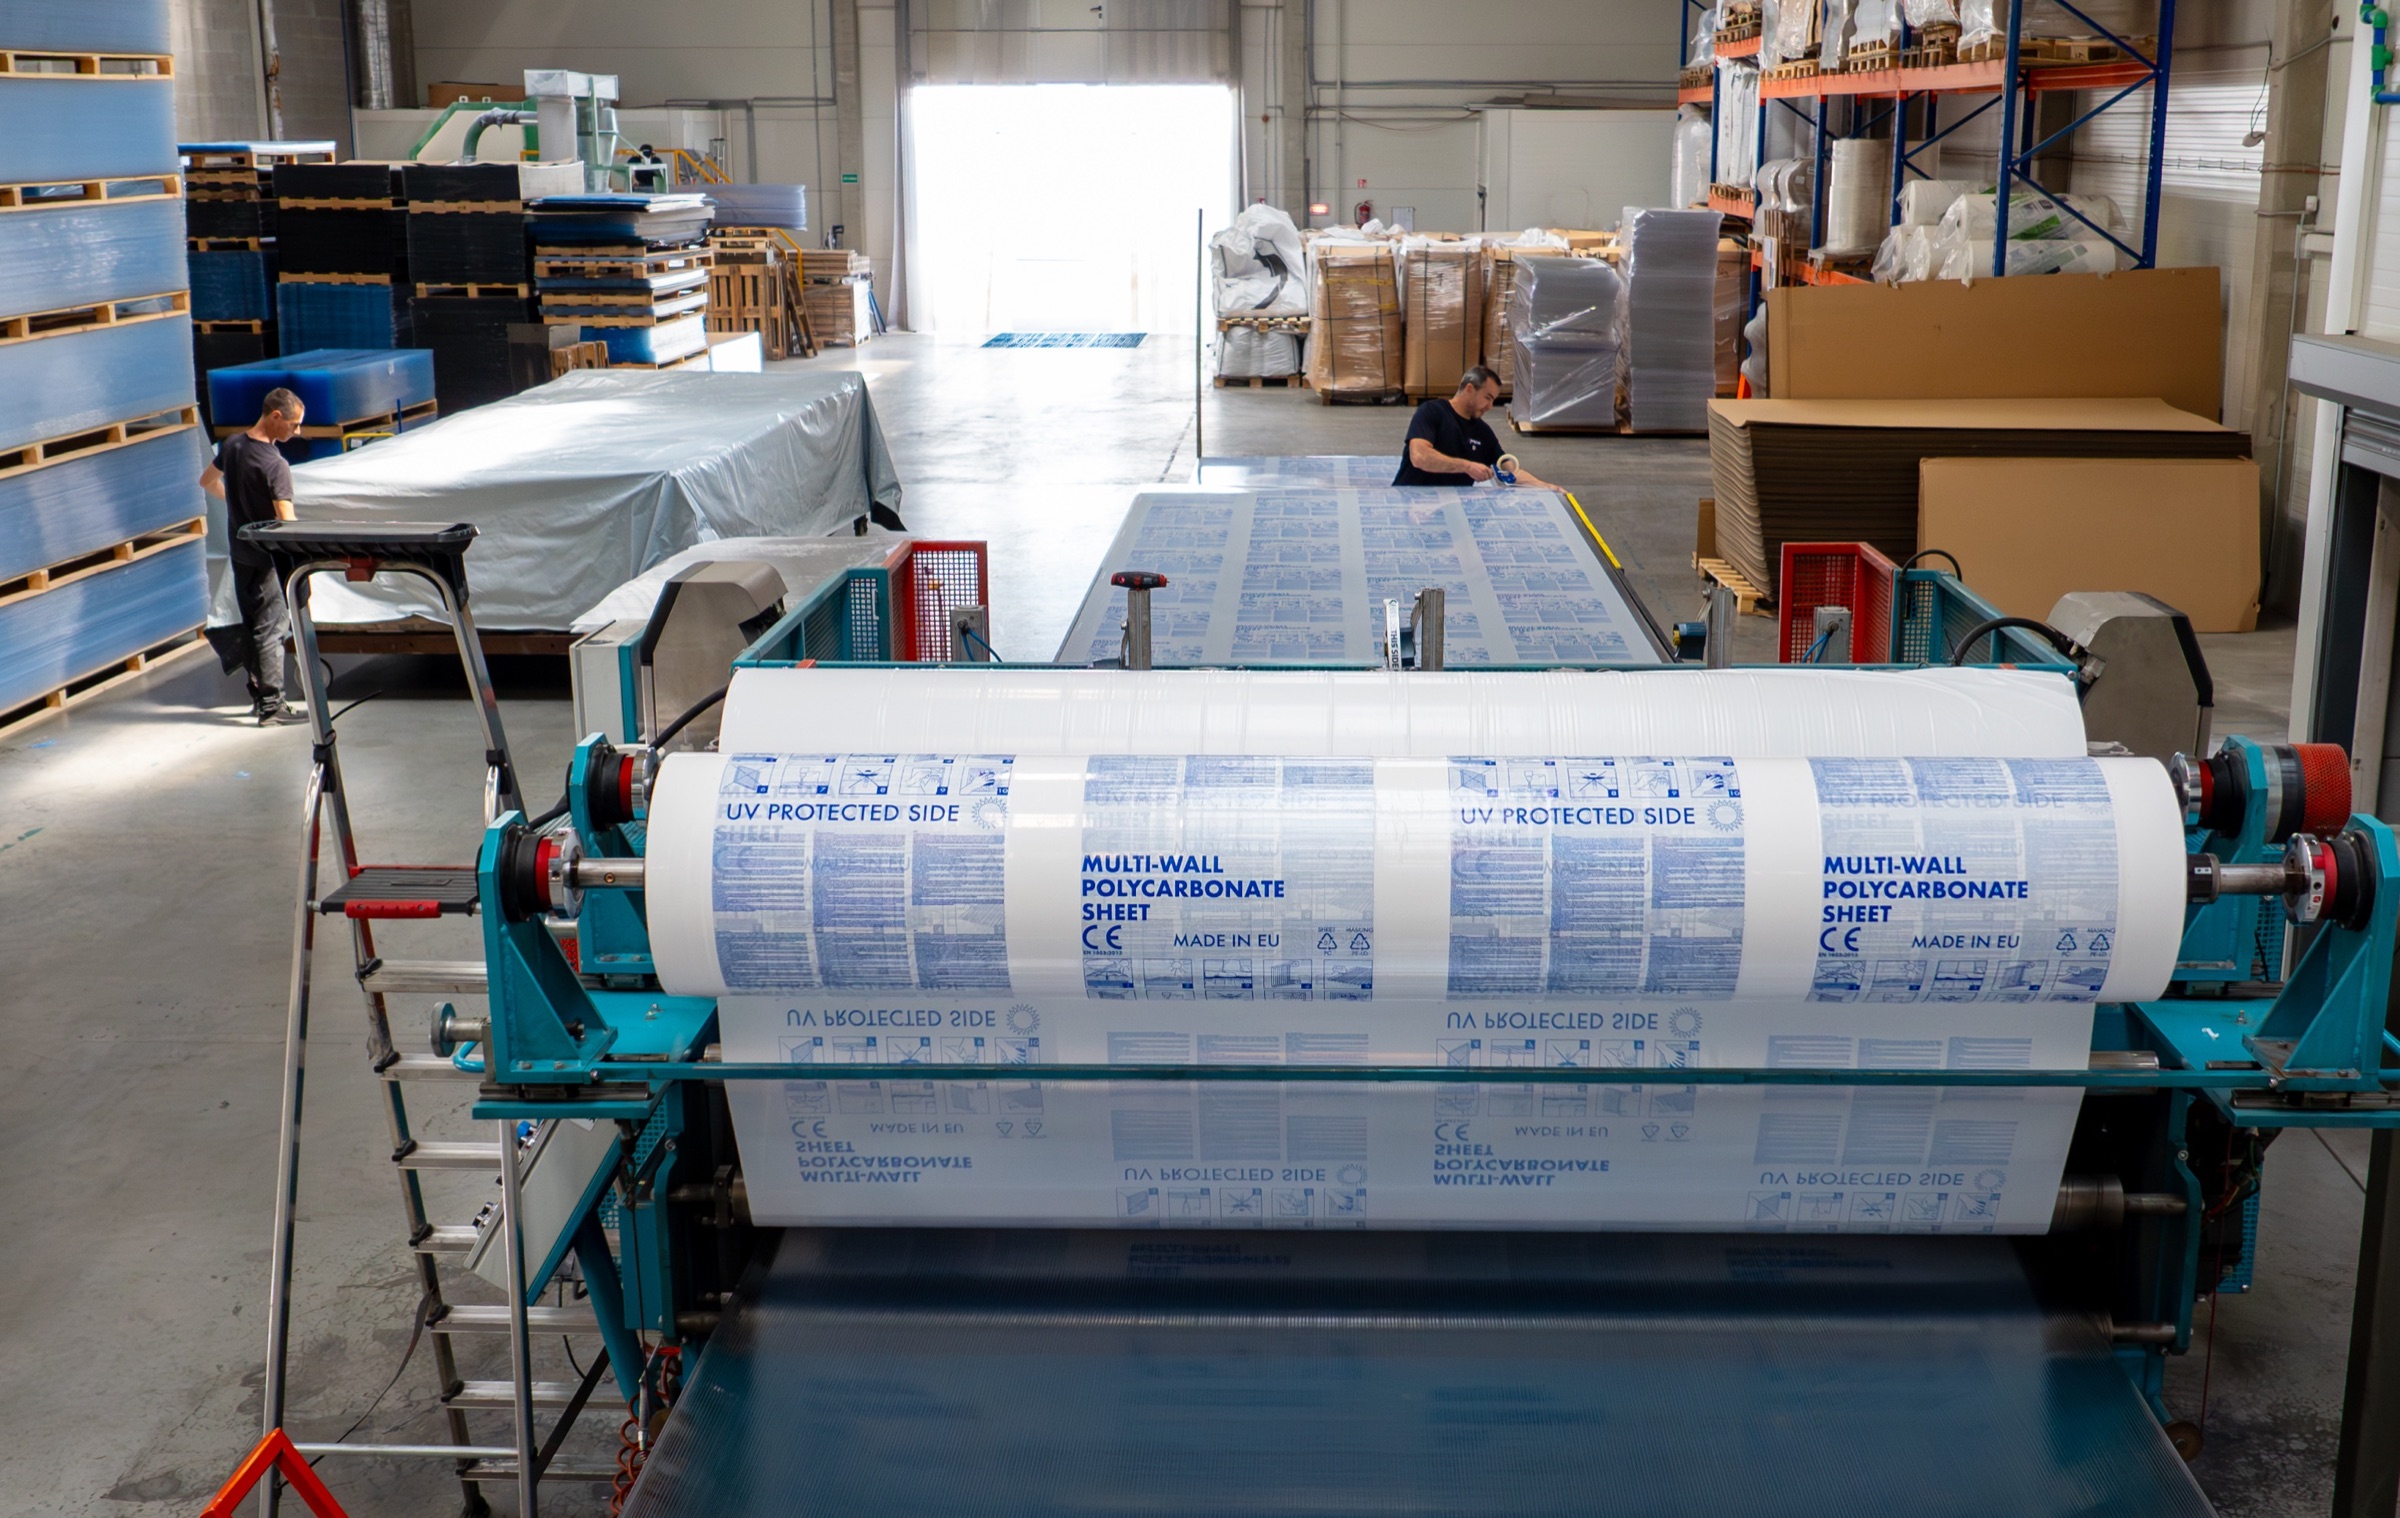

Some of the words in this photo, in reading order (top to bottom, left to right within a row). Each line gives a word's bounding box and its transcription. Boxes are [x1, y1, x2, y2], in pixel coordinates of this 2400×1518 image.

[1391, 649, 1399, 668] SIDE
[727, 804, 761, 820] UV
[768, 804, 899, 821] PROTECTED
[909, 805, 960, 821] SIDE
[1461, 808, 1493, 825] UV
[1504, 808, 1635, 825] PROTECTED
[1645, 808, 1696, 824] SIDE
[1081, 855, 1223, 873] MULTI-WALL
[1823, 857, 1966, 874] MULTI-WALL
[1082, 880, 1285, 898] POLYCARBONATE
[1823, 881, 2028, 898] POLYCARBONATE
[1082, 903, 1150, 921] SHEET
[1822, 905, 1892, 922] SHEET
[1174, 934, 1226, 947] MADE
[1232, 934, 1251, 947] IN
[1258, 934, 1280, 947] EU
[1911, 936, 1965, 948] MADE
[1971, 936, 1990, 948] IN
[1997, 936, 2020, 948] EU
